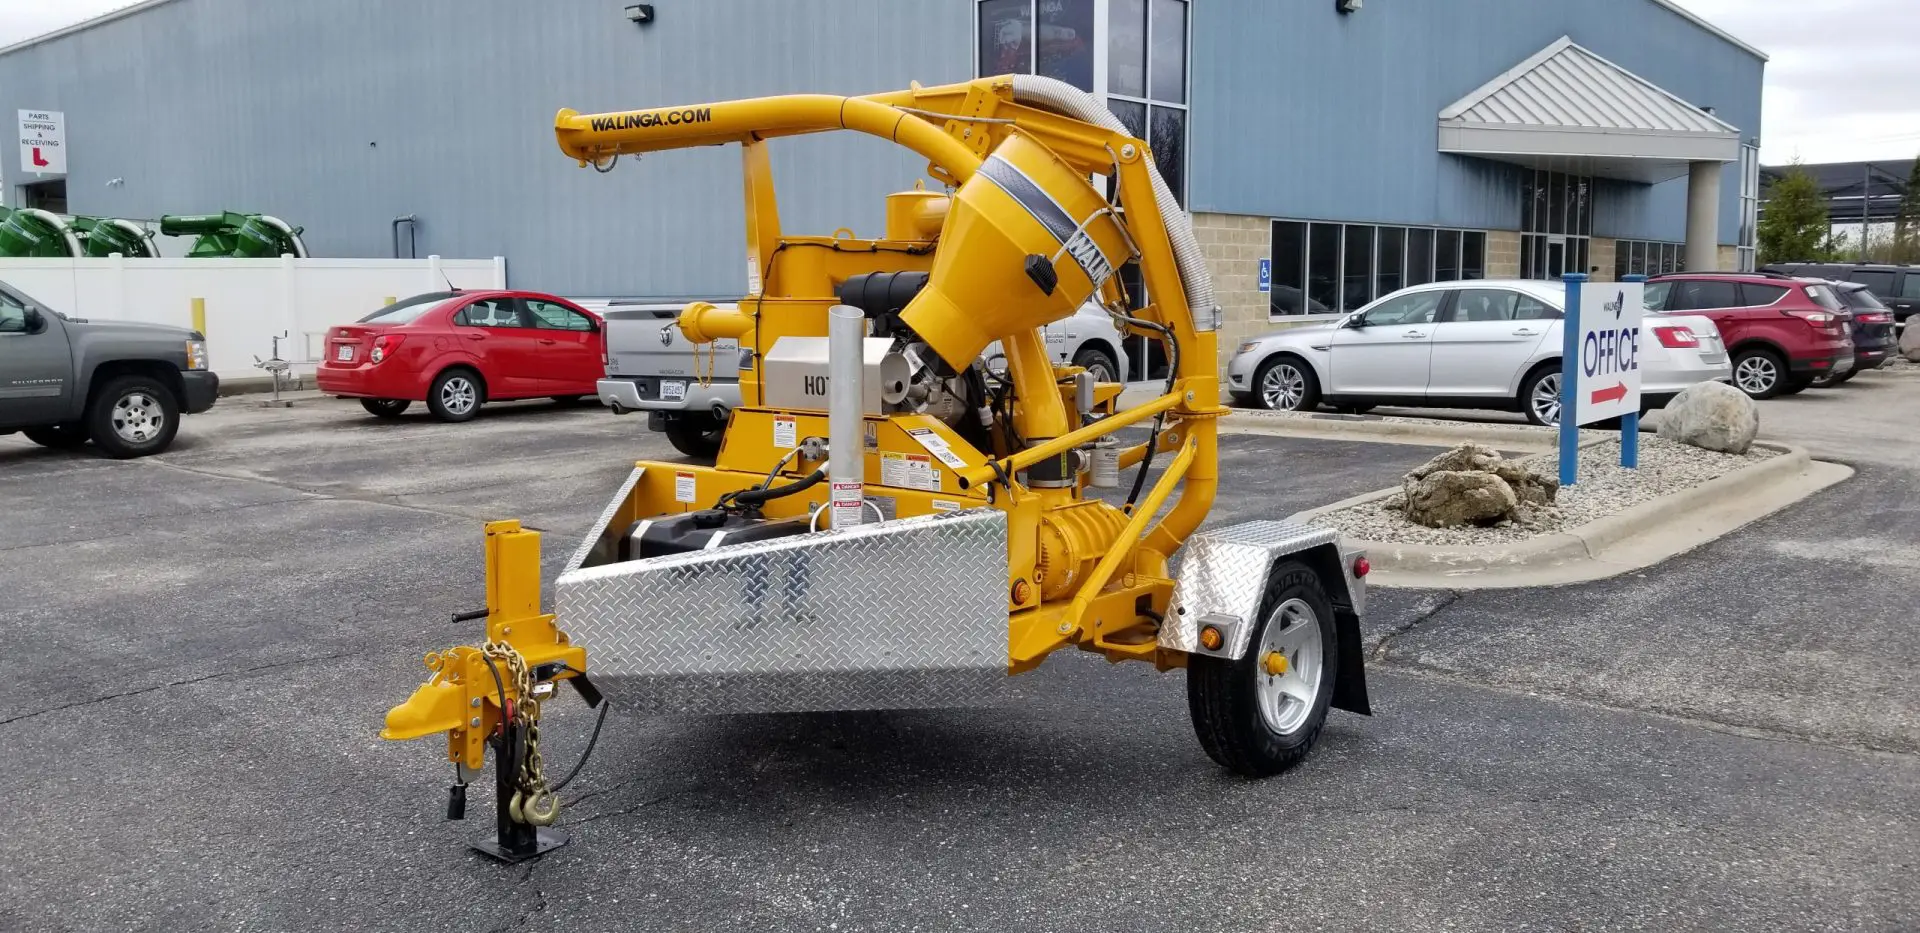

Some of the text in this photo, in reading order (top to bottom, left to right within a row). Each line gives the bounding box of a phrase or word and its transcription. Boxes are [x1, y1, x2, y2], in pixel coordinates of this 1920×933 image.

[28, 113, 50, 121] PARTS
[591, 108, 711, 132] WALINGA.COM
[23, 123, 56, 131] SHIPPING
[21, 139, 60, 147] RECEIVING
[1583, 327, 1639, 378] OFFICE
[804, 375, 830, 396] HO
